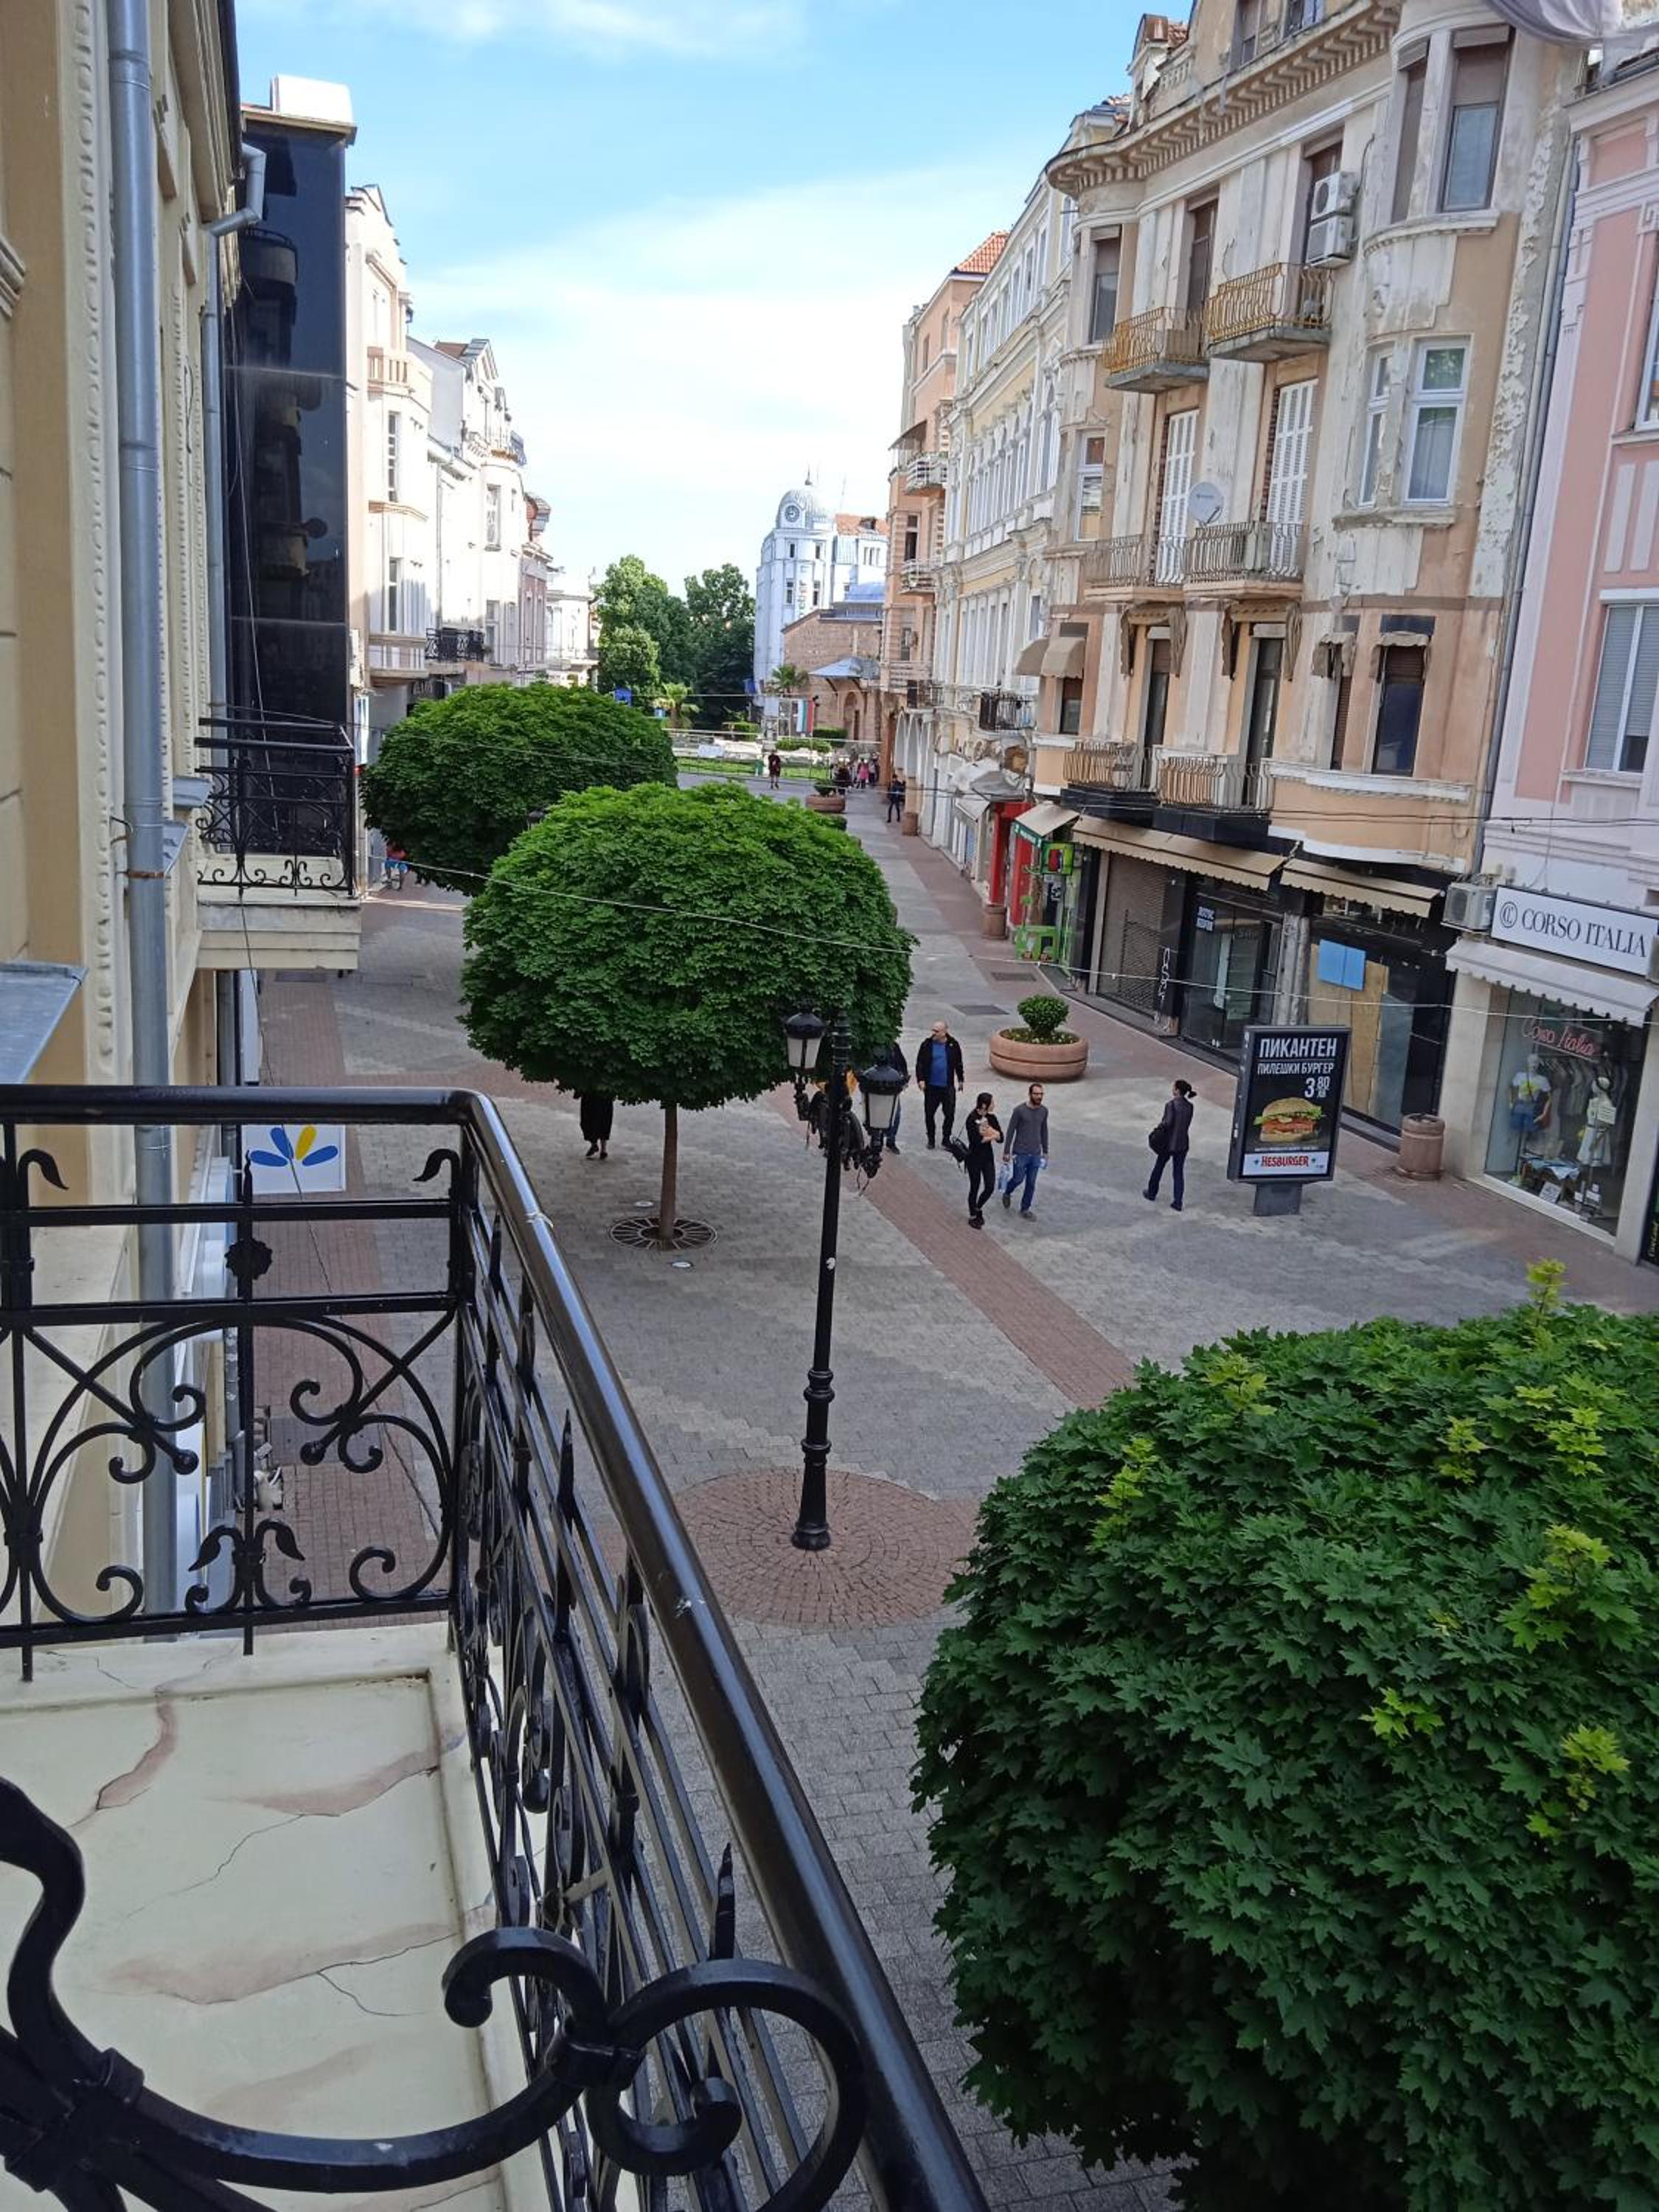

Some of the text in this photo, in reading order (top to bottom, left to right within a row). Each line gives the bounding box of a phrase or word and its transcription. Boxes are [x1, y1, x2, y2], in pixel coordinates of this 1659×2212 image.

[1522, 908, 1581, 942] CORSO
[1585, 923, 1646, 958] ITALIA
[1259, 1037, 1337, 1057] ПИКАНТЕН
[1257, 1062, 1334, 1074] ПИЛЕШКИ БУРГЕР
[1304, 1076, 1330, 1098] 3 80
[1262, 1155, 1309, 1167] HESBURGER
